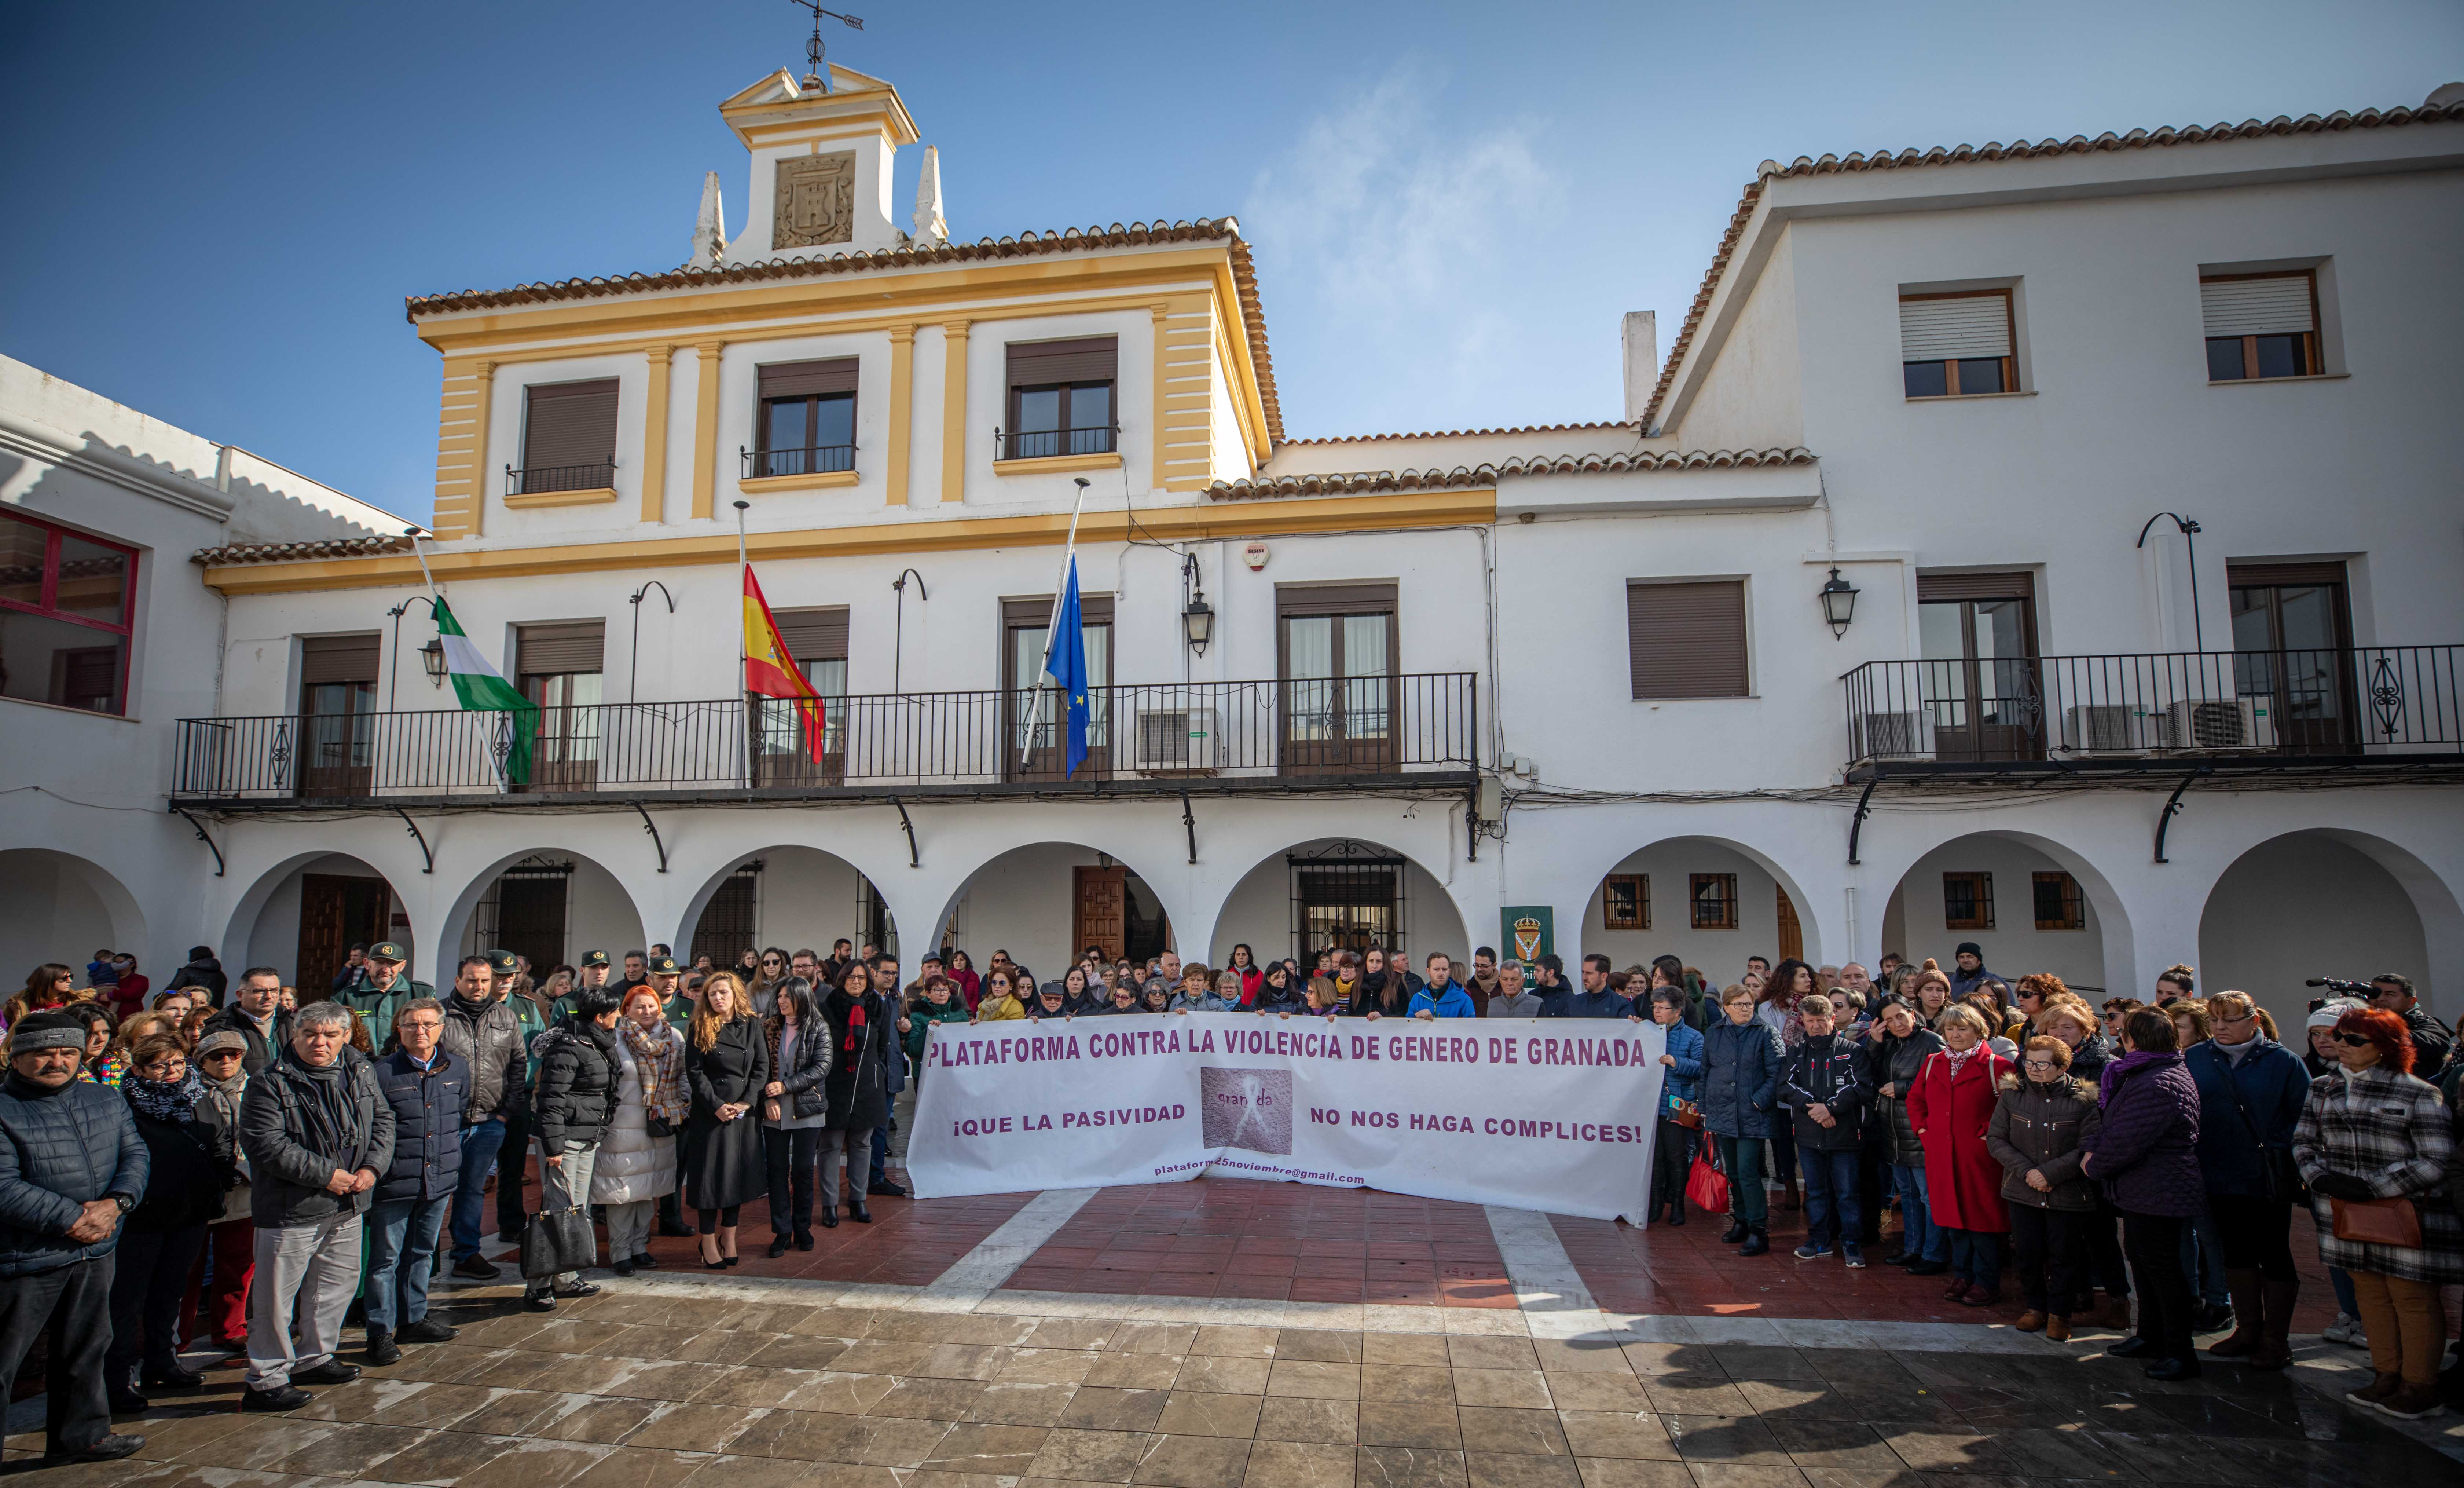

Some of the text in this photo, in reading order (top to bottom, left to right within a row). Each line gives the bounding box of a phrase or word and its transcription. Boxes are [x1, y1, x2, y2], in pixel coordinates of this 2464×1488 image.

[928, 1029, 1646, 1067] PLATAFORMA CONTRA LA VIOLENCIA DE GENERO DE GRANADA
[954, 1104, 1185, 1136] ¡QUE LA PASIVIDAD
[1310, 1108, 1642, 1143] NO NOS HAGA COMPLICES!
